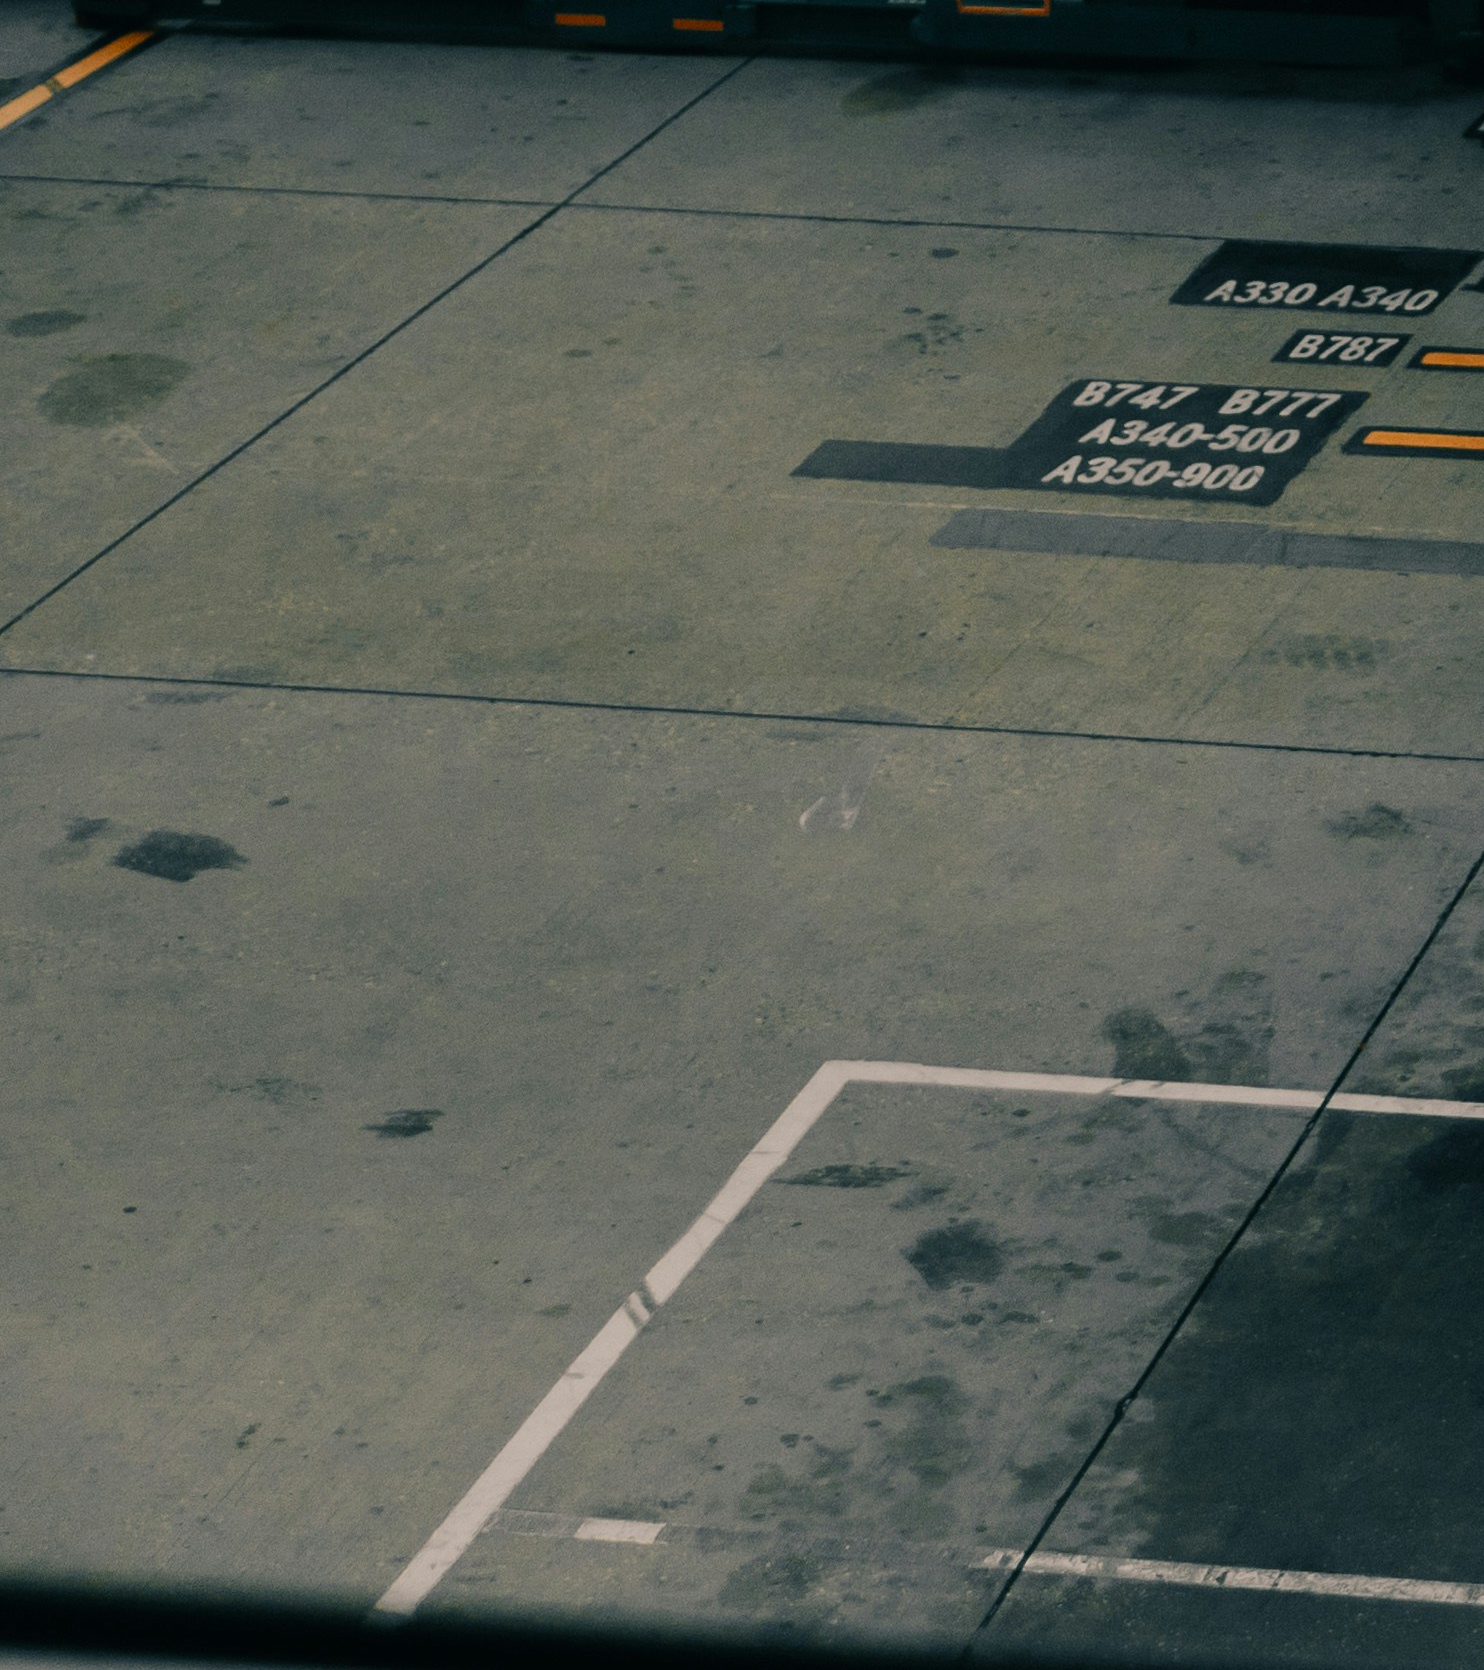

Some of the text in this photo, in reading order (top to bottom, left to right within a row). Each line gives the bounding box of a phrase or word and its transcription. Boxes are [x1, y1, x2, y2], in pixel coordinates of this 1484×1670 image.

[1204, 279, 1438, 311] A330 A340
[1289, 334, 1399, 362] B787
[1073, 381, 1341, 418] B747 B777
[1078, 418, 1300, 454] A340-500
[1041, 455, 1264, 490] A350-900
